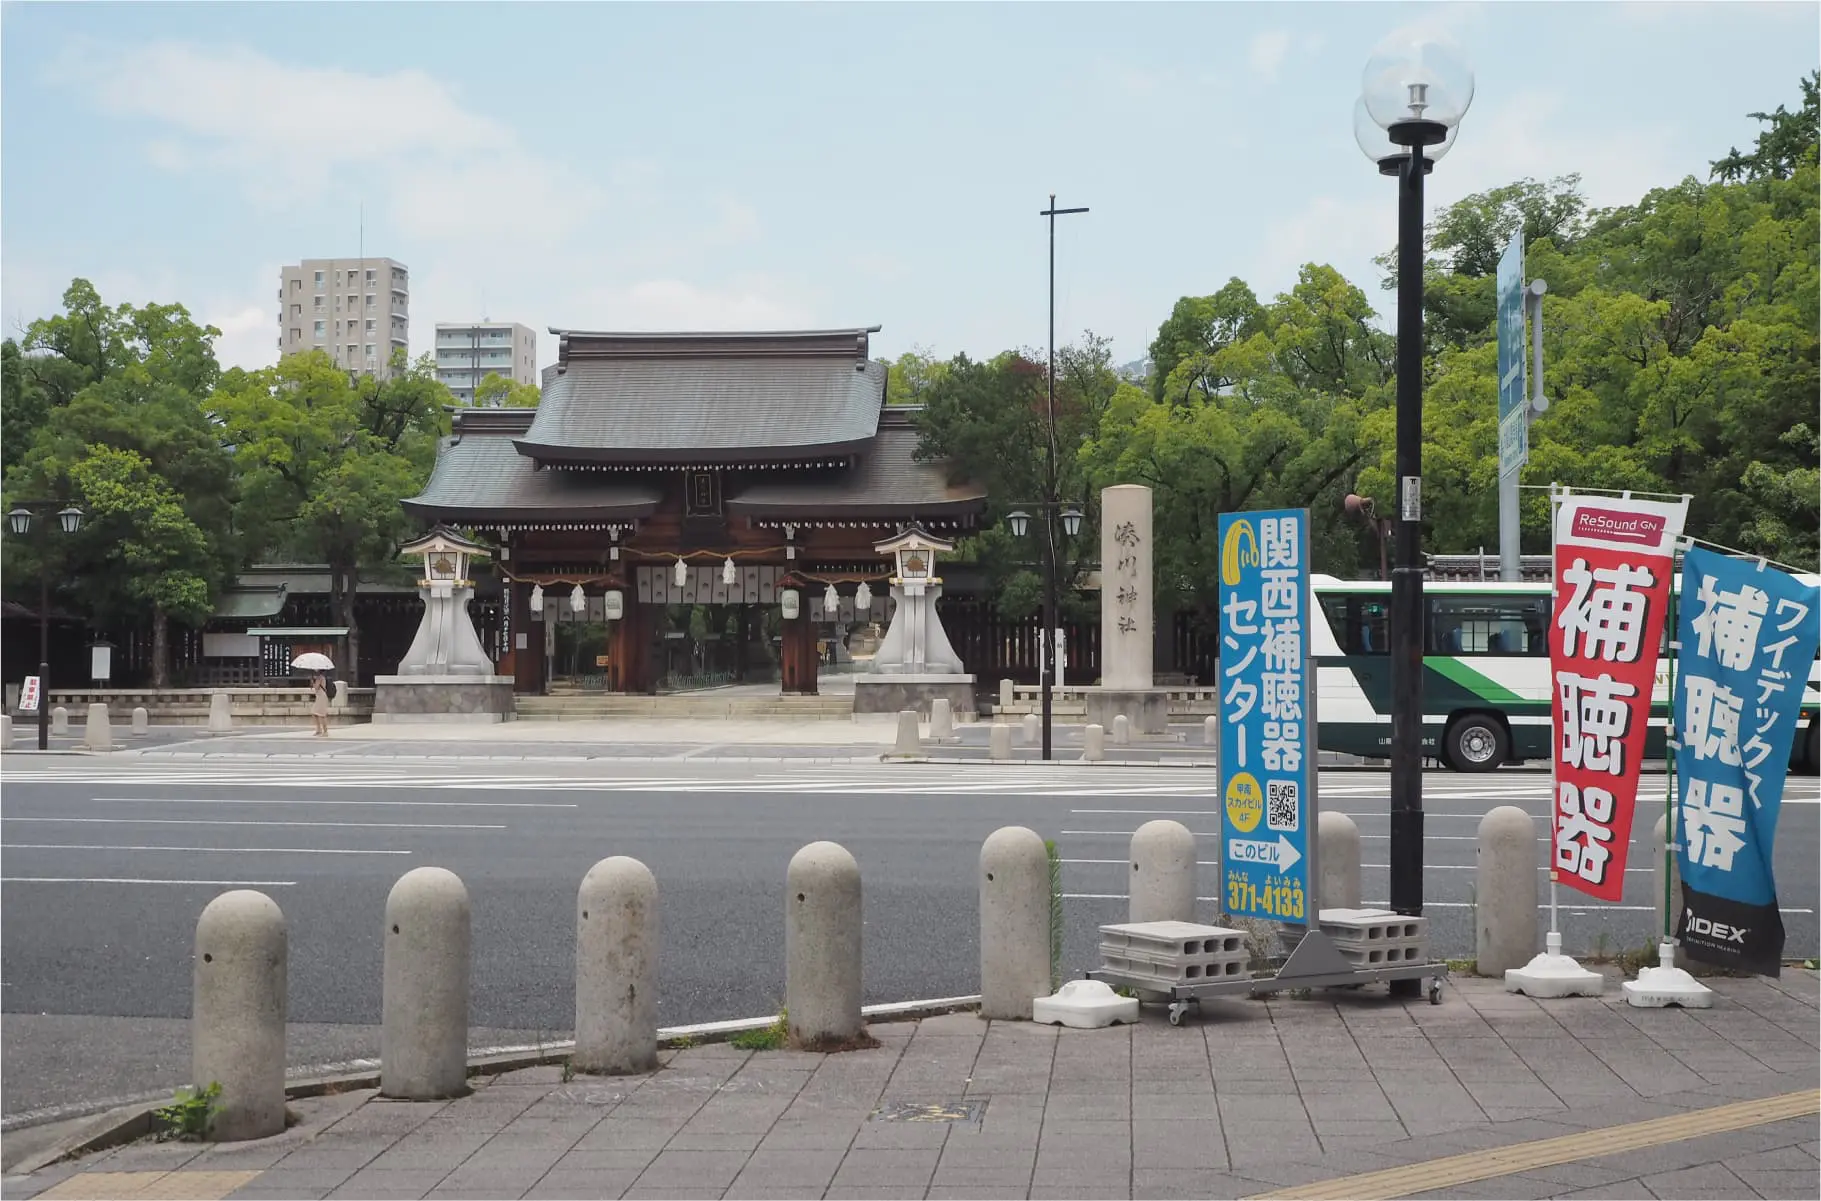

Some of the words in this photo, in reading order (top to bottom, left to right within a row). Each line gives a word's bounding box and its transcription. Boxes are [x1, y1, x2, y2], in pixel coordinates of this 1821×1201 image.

[1579, 513, 1638, 530] ReSound
[1640, 521, 1657, 531] GN
[1259, 517, 1303, 772] 関西補聴器
[1223, 590, 1258, 769] センター
[1556, 558, 1657, 884] 補聴器
[1683, 574, 1770, 873] 補聴器
[1227, 797, 1262, 811] スカイビル
[1239, 812, 1251, 823] 4F
[1234, 843, 1280, 862] このビル
[1228, 869, 1249, 882] みんな
[1228, 881, 1304, 918] 371-4133
